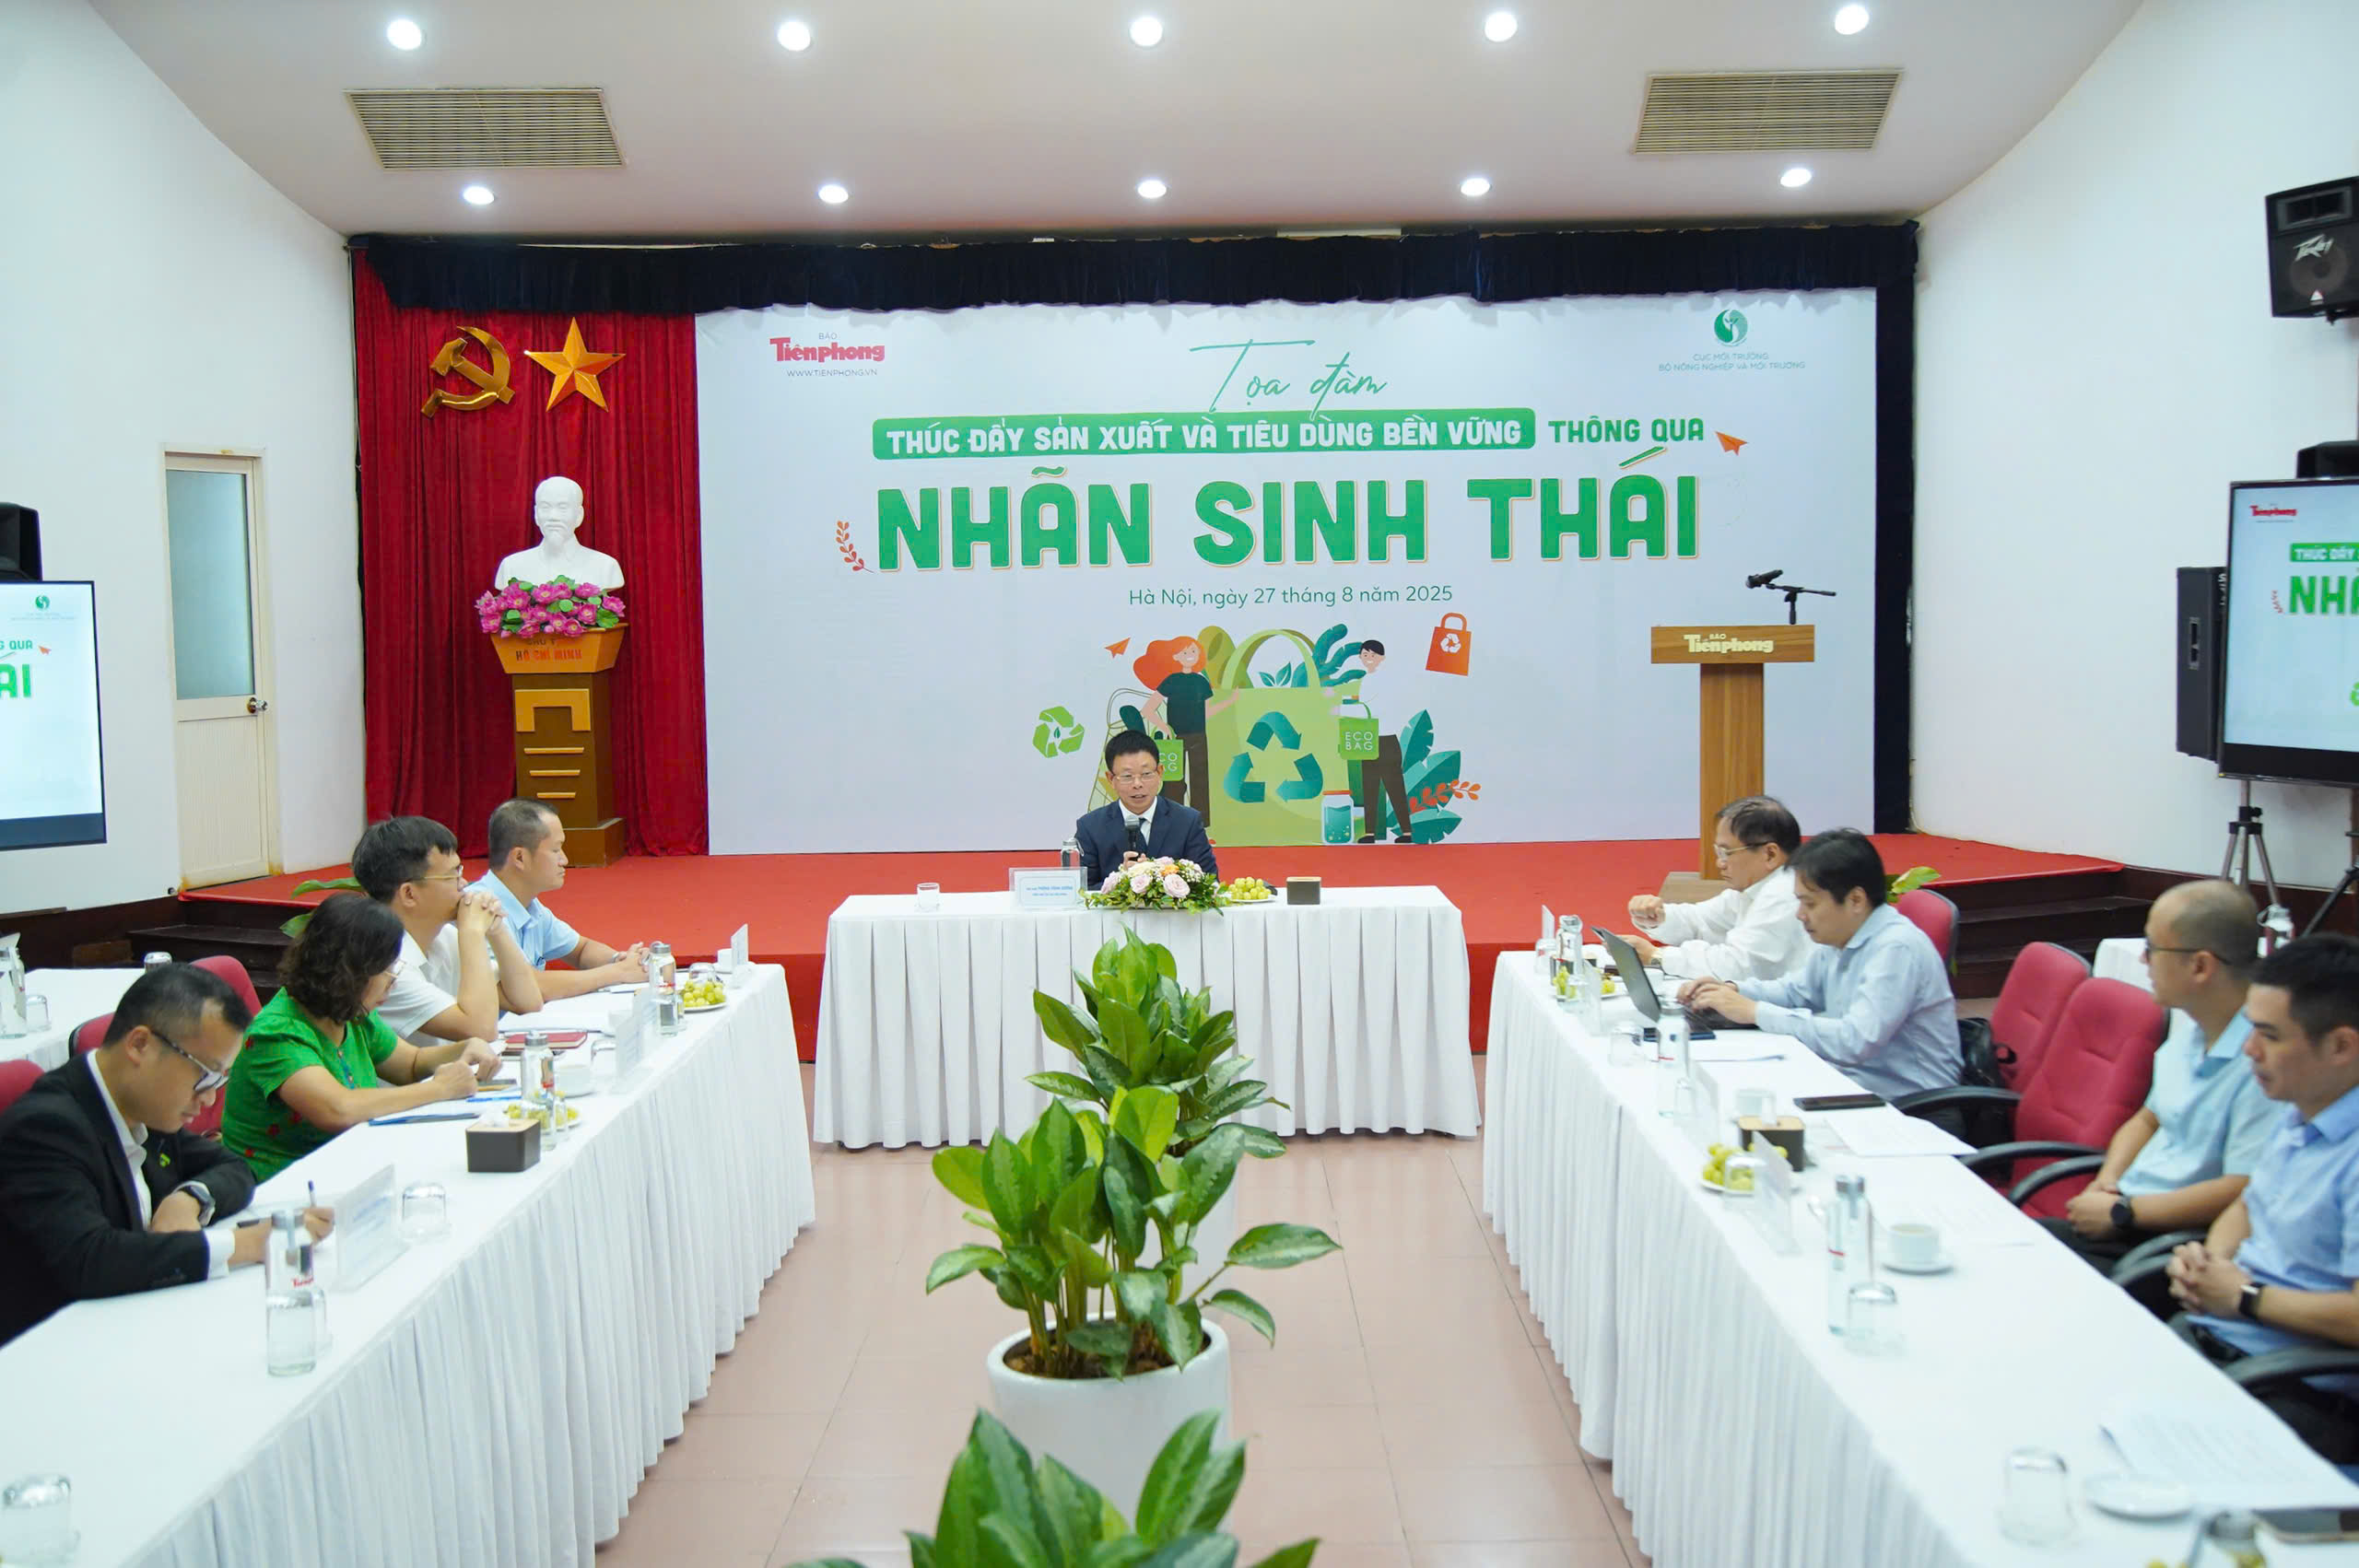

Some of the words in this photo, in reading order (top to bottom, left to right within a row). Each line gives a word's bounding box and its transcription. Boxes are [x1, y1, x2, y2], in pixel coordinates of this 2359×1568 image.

[1190, 339, 1315, 413] Tọa
[1309, 352, 1387, 421] đàm
[886, 422, 960, 454] THÚC
[968, 417, 1026, 452] ĐẨY
[1034, 415, 1088, 451] SẢN
[1098, 418, 1172, 450] XUẤT
[1182, 416, 1216, 449] VÀ
[1226, 420, 1288, 448] TIÊU
[1299, 415, 1373, 447] DÙNG
[1384, 414, 1438, 446] BỀN
[1448, 416, 1520, 445] VỮNG
[1548, 415, 1640, 442] THÔNG
[1651, 417, 1704, 442] QUA
[877, 466, 1152, 571] NHÃN
[1193, 480, 1427, 568] SINH
[1467, 446, 1698, 561] THÁI
[1129, 588, 1155, 604] Hà
[1161, 587, 1197, 607] Nội,
[1203, 588, 1248, 609] ngày
[1254, 588, 1276, 603] 27
[1282, 586, 1335, 607] tháng
[1342, 587, 1354, 603] 8
[1359, 586, 1400, 602] năm
[1405, 585, 1453, 602] 2025
[1345, 731, 1373, 741] ECO
[1345, 741, 1373, 751] BAG
[1158, 752, 1178, 762] CO
